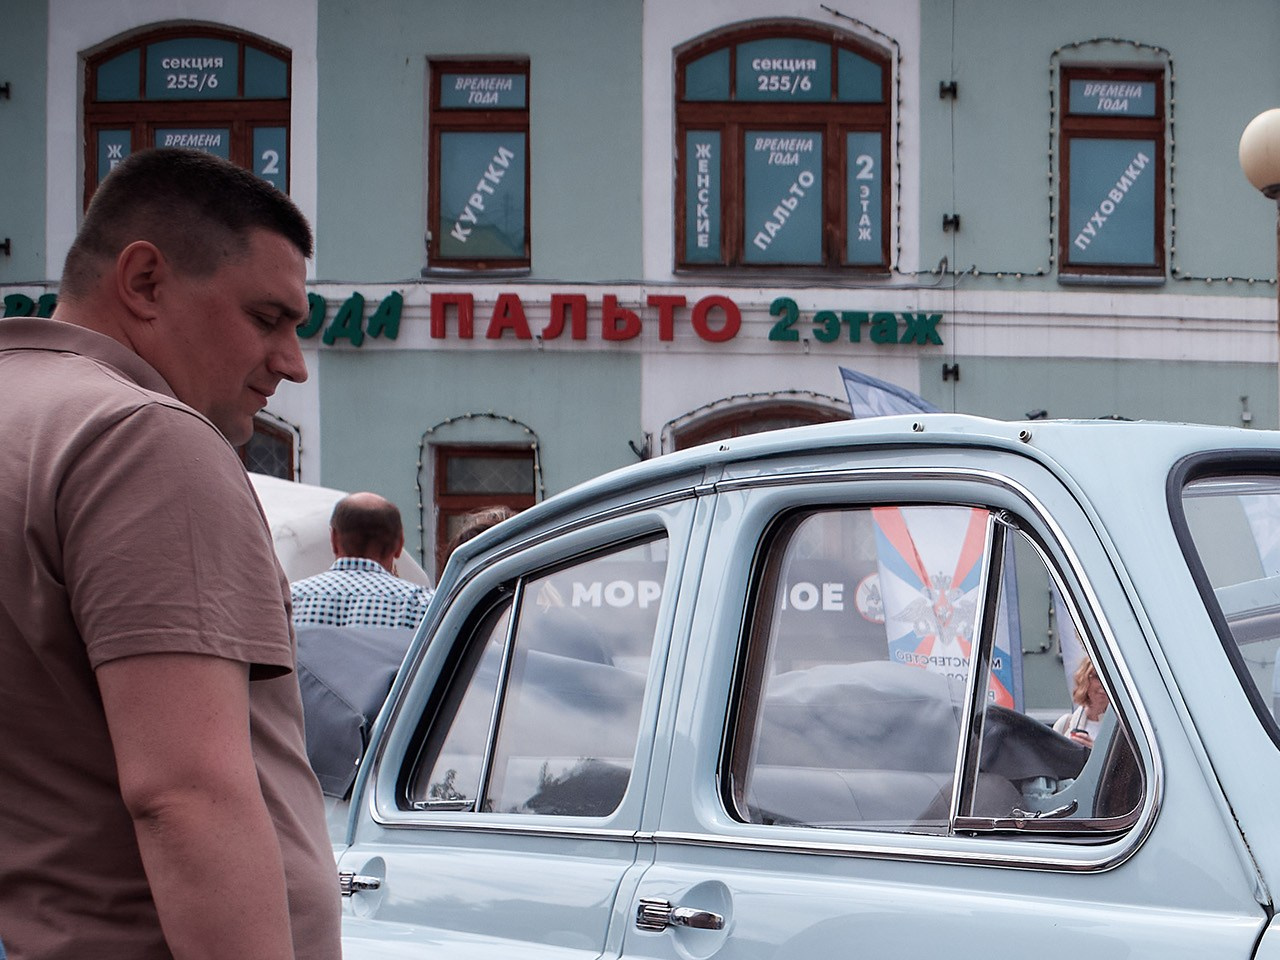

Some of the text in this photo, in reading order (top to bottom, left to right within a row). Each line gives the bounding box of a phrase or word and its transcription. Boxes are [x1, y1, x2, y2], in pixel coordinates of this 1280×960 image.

[162, 57, 224, 71] секция
[752, 58, 817, 73] секция
[167, 74, 218, 92] 255/6
[455, 78, 512, 91] ВРЕМЕНА
[757, 75, 812, 95] 255/6
[1083, 83, 1142, 98] ВРЕМЕНА
[468, 91, 499, 104] ГОДА
[1097, 98, 1128, 111] ГОДА
[164, 134, 221, 147] ВРЕМЕНА
[754, 137, 813, 151] ВРЕМЕНА
[261, 150, 279, 175] 2
[768, 151, 800, 165] ГОДА
[855, 154, 874, 180] 2
[450, 146, 515, 243] КУРТКИ
[695, 143, 711, 249] ЖЕНСКИЕ
[1074, 152, 1150, 250] ПУХОВИКИ
[753, 170, 815, 251] ПАЛЬТО
[296, 291, 943, 347] ОДА ПАЛЬТО 2 этаж
